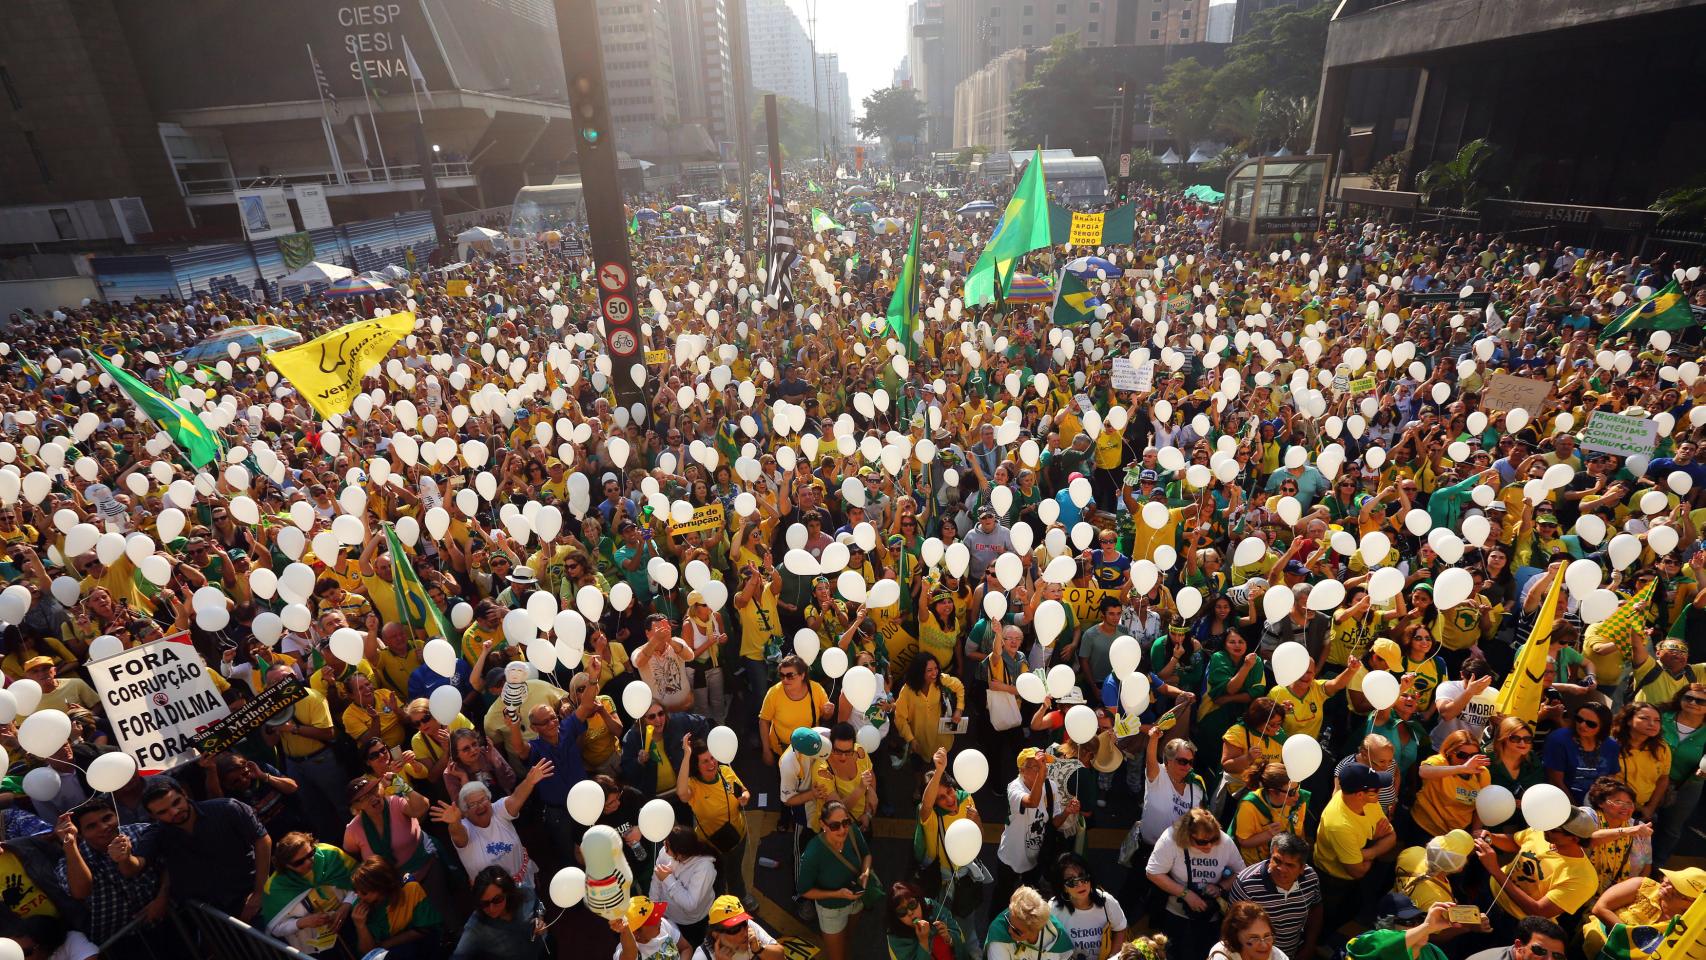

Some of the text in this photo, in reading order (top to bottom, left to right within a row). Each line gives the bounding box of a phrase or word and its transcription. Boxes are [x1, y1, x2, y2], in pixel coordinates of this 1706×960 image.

[338, 4, 400, 27] CIESP
[345, 32, 393, 54] SESI
[1545, 208, 1592, 223] ASAHI
[609, 302, 627, 314] 50
[1586, 429, 1623, 440] CONTRA
[672, 514, 722, 530] corrupção!
[706, 508, 718, 516] de
[1062, 588, 1108, 604] ORA
[108, 647, 180, 682] FORA
[107, 662, 201, 707] CORRUPÇÃO
[118, 705, 169, 741] FORA
[163, 689, 222, 728] DILMA
[192, 729, 215, 744] Sim,
[213, 722, 226, 732] eu
[226, 698, 258, 723] acredito
[257, 688, 277, 703] num
[227, 696, 276, 734] Melhor!
[135, 733, 192, 768] FORA
